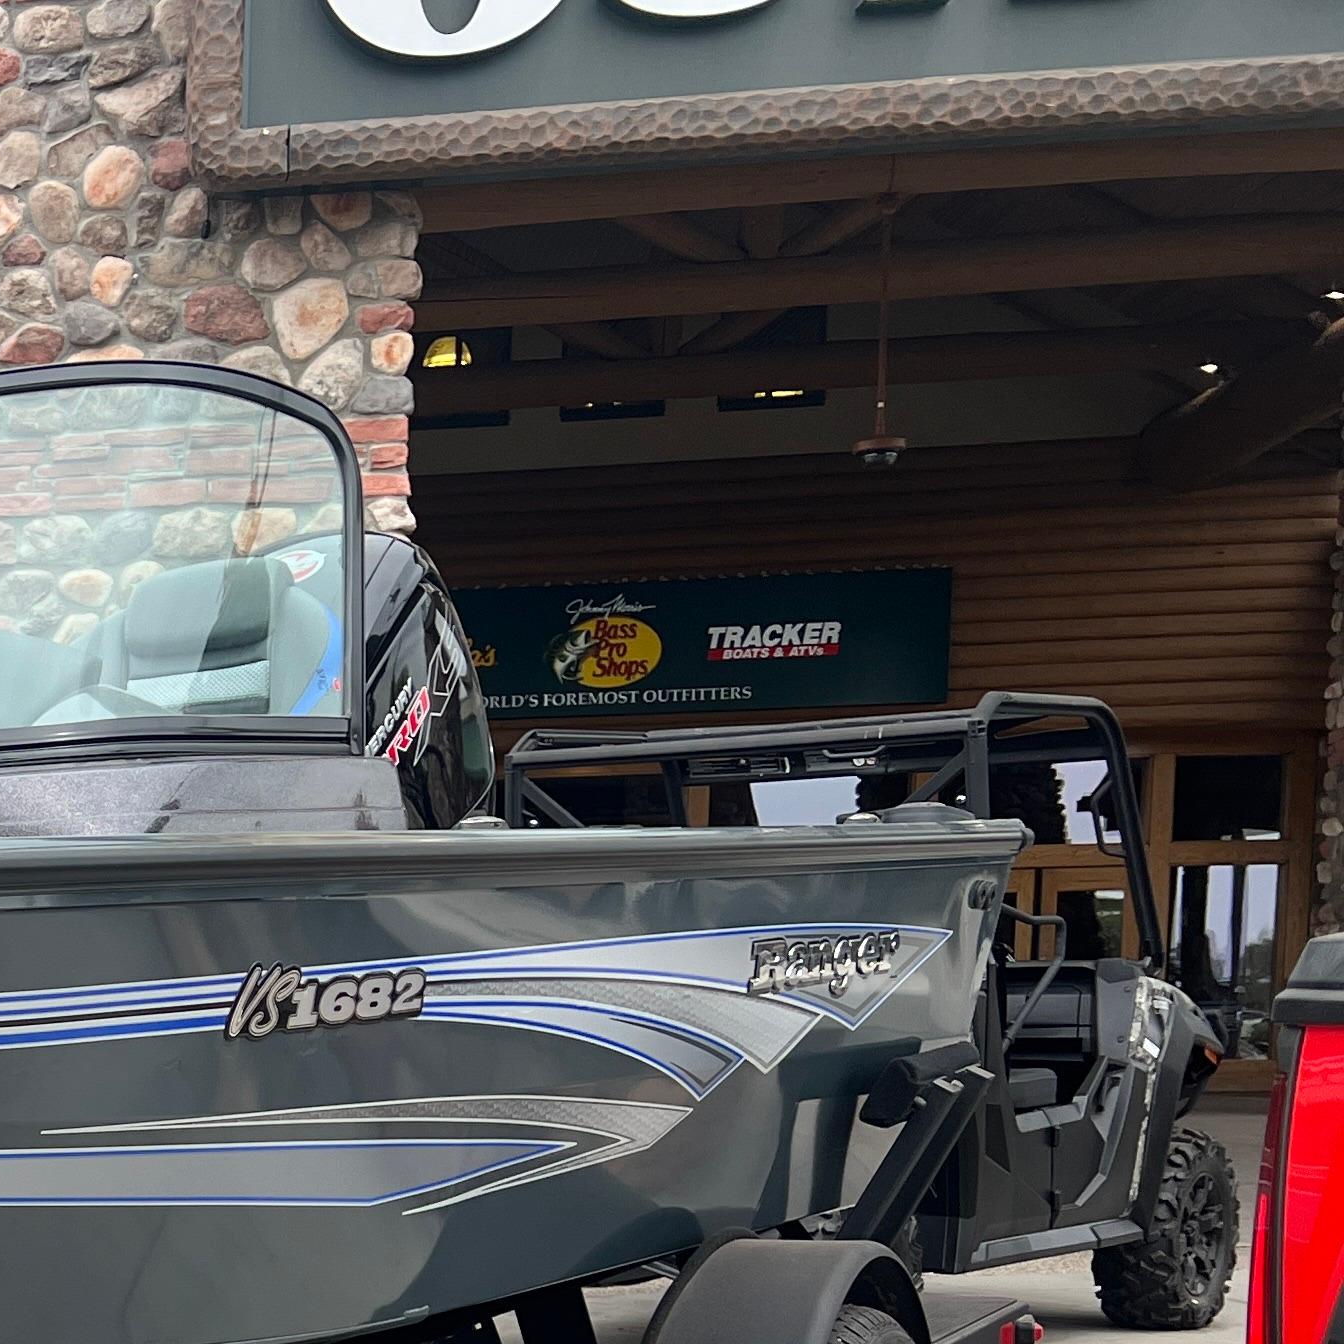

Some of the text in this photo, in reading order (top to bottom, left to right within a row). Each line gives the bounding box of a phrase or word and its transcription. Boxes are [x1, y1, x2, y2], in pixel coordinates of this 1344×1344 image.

[592, 619, 637, 640] Bass
[707, 621, 842, 649] TRACKER
[593, 639, 627, 658] Pro
[722, 645, 824, 660] BOATS & ATVs
[592, 656, 649, 681] Shops
[481, 685, 753, 710] ORLD'S FOREMOST OUTFITTERS
[382, 686, 431, 767] RO
[747, 929, 900, 998] Ranger
